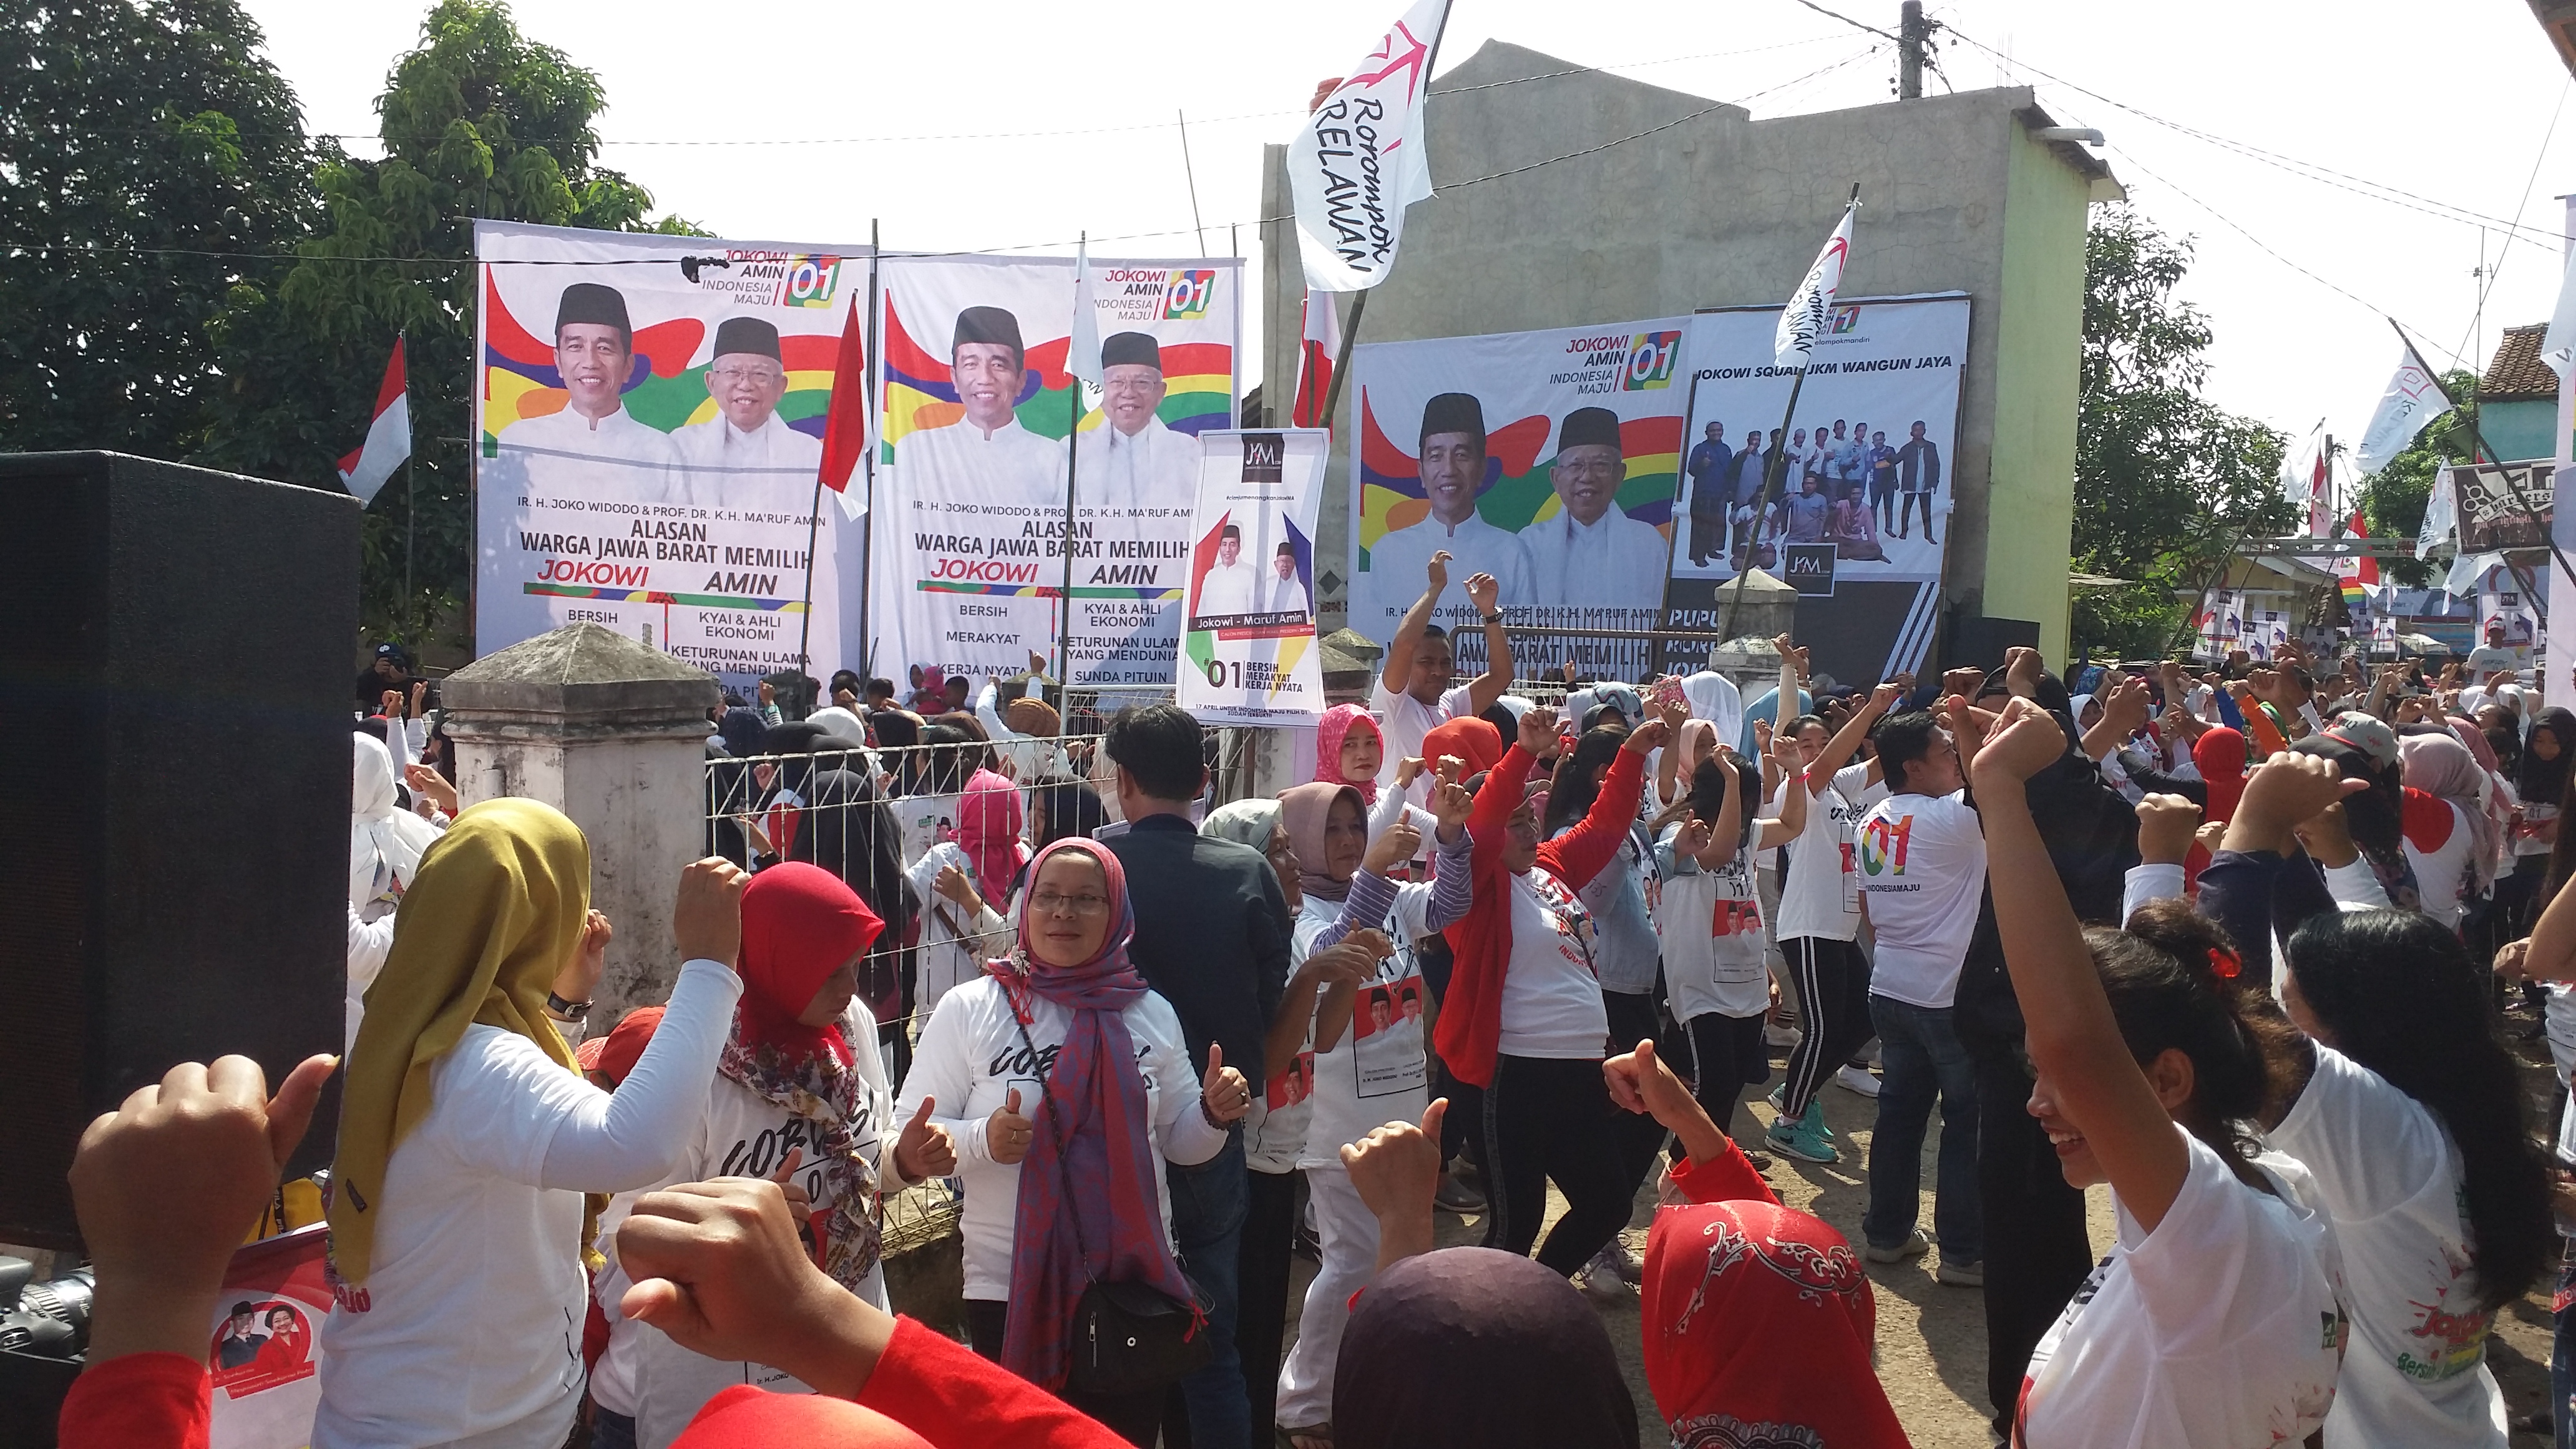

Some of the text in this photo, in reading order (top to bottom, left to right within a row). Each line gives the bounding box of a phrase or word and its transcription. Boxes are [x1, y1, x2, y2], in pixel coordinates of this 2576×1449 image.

[1315, 99, 1372, 273] RELAWAN
[726, 250, 788, 265] JOKOWI
[740, 263, 836, 300] AMIN 01
[1105, 270, 1166, 283] JOKOWI
[702, 280, 772, 293] INDONESIA
[1123, 277, 1211, 311] AMIN 01
[734, 293, 771, 305] MAJU
[1093, 298, 1152, 310] NDONESIA
[1118, 310, 1151, 321] MAJU
[1566, 334, 1629, 353] JOKOWI
[1584, 341, 1675, 381] AMIN 01
[1695, 368, 1750, 381] JOKOWI
[1807, 363, 1837, 374] JKM
[1842, 358, 1912, 373] WANGUN
[1915, 356, 1952, 369] JAYA
[1549, 370, 1612, 384] INDONESIA
[1577, 383, 1611, 395] MAJU
[517, 496, 826, 527] IR. H. JOKO WIDODO & PROF. DR. K.H. MA'RUF AMN
[913, 500, 1193, 518] IR. H. JOKO WIDODO & PRO. DR. K.H. MA'RUF AMI
[631, 519, 706, 543] ALASAN
[1022, 520, 1093, 539] ALASAN
[520, 532, 811, 570] WARGA JAWA BARAT MEMILIH
[914, 533, 1189, 559] WARGA JAWA BARAT MEMILIH
[537, 559, 778, 595] JOKOWI AMIN
[930, 559, 1158, 585] JOKOWI AMIN
[568, 609, 781, 628] BERSIH KYAI & AHLI
[959, 603, 1161, 618] BERSIH KYAI & AHLI
[1386, 607, 1398, 617] IR.
[1445, 608, 1481, 617] WIDOD
[1090, 616, 1155, 628] EKONOMI
[1198, 616, 1234, 629] Jokowi
[1244, 615, 1276, 626] Maruf
[1279, 612, 1302, 624] Amin
[705, 626, 775, 641] EKONOMI
[946, 631, 1020, 645] MERAKYAT
[1143, 637, 1179, 648] ULAM
[671, 645, 812, 665] KETURUNAN ULAMA
[1067, 649, 1178, 661] YANG MENDUNIA
[938, 663, 1027, 676] KERJA NYATA
[1247, 662, 1279, 673] BERSIH
[1075, 671, 1167, 683] SUNDA PITUIN
[1246, 671, 1291, 683] MERAKYAT
[1245, 680, 1303, 693] KERJA NYATA
[1862, 814, 1915, 876] 01
